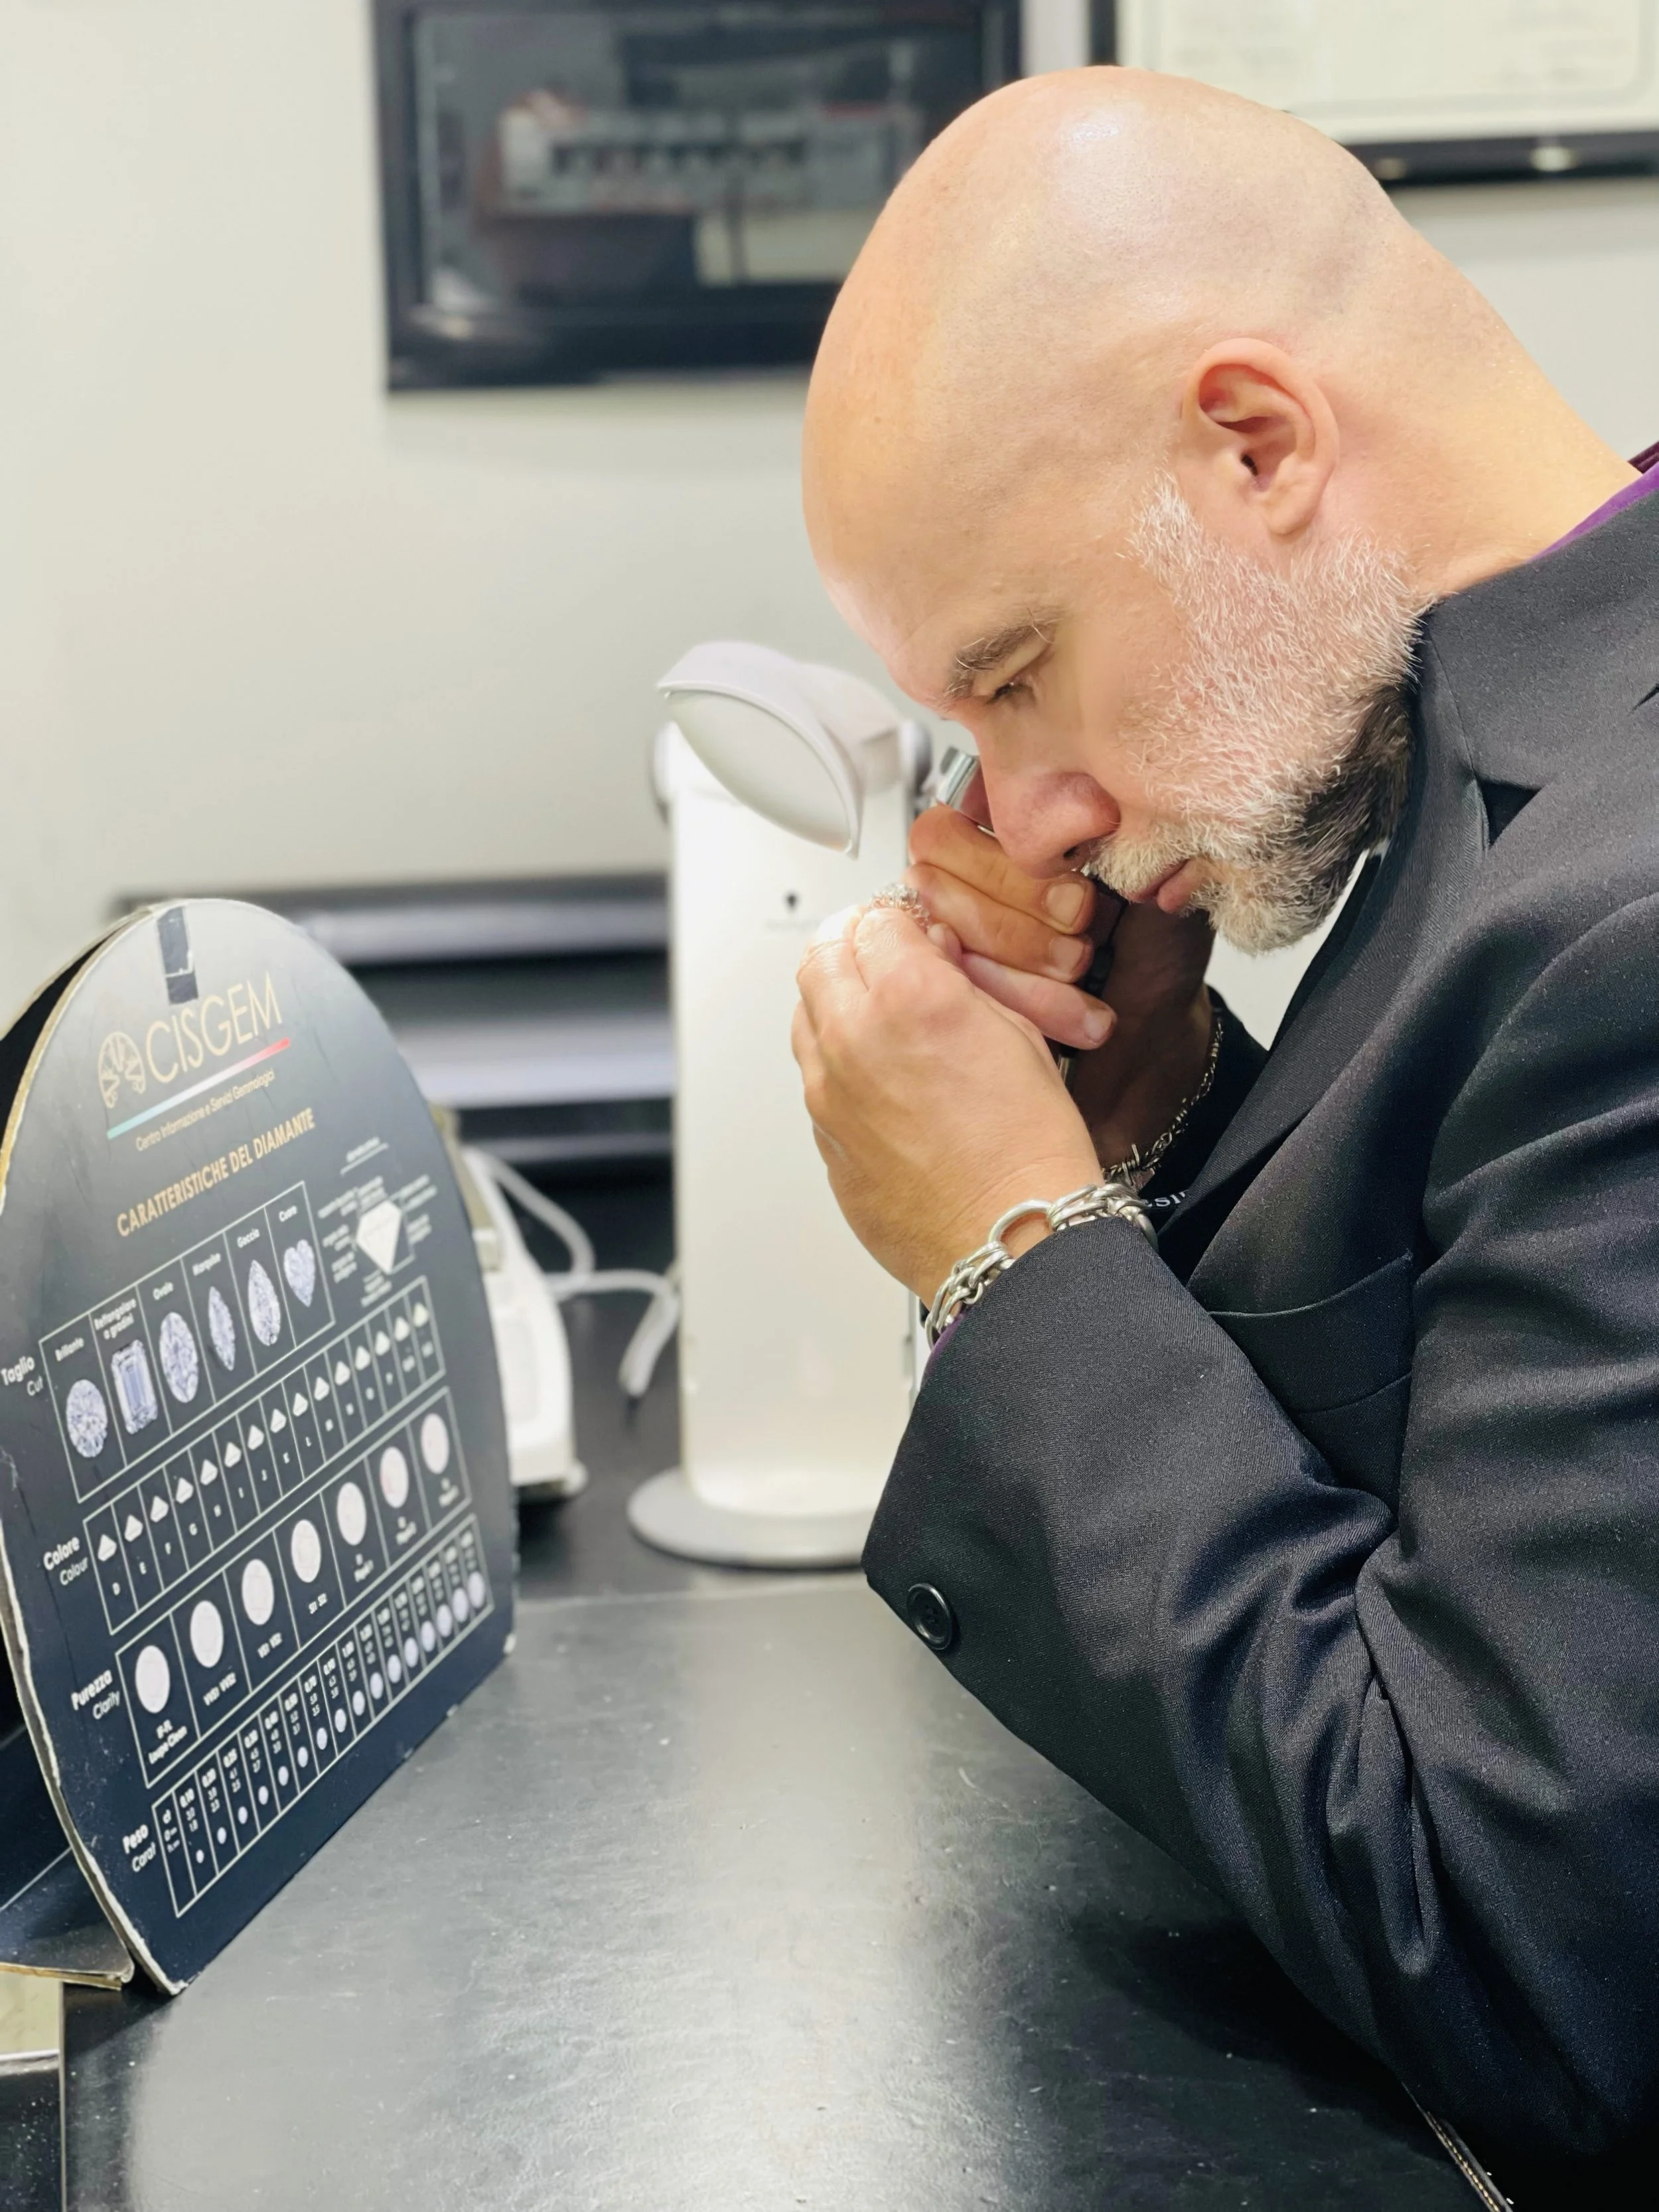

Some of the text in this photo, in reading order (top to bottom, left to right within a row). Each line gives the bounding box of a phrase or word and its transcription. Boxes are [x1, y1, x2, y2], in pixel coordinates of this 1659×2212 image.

[146, 972, 282, 1083] CISGEM
[135, 1131, 161, 1151] Centro
[160, 1105, 205, 1138] Informazione
[210, 1092, 233, 1112] Servizi
[233, 1067, 275, 1100] Gemmologici
[117, 1157, 229, 1236] CARATTERISTICHE
[229, 1143, 253, 1173] DEL
[253, 1107, 316, 1159] DIAMANTE
[237, 1228, 260, 1248] Goccia
[1, 1356, 35, 1385] Taglio
[27, 1375, 44, 1396] Cut
[188, 1522, 198, 1536] G
[43, 1536, 80, 1571] Colore
[60, 1556, 88, 1585] Colour
[70, 1669, 113, 1711] Purezza
[92, 1690, 120, 1720] Clarity
[122, 1824, 149, 1854] Peso
[131, 1841, 156, 1872] Carat
